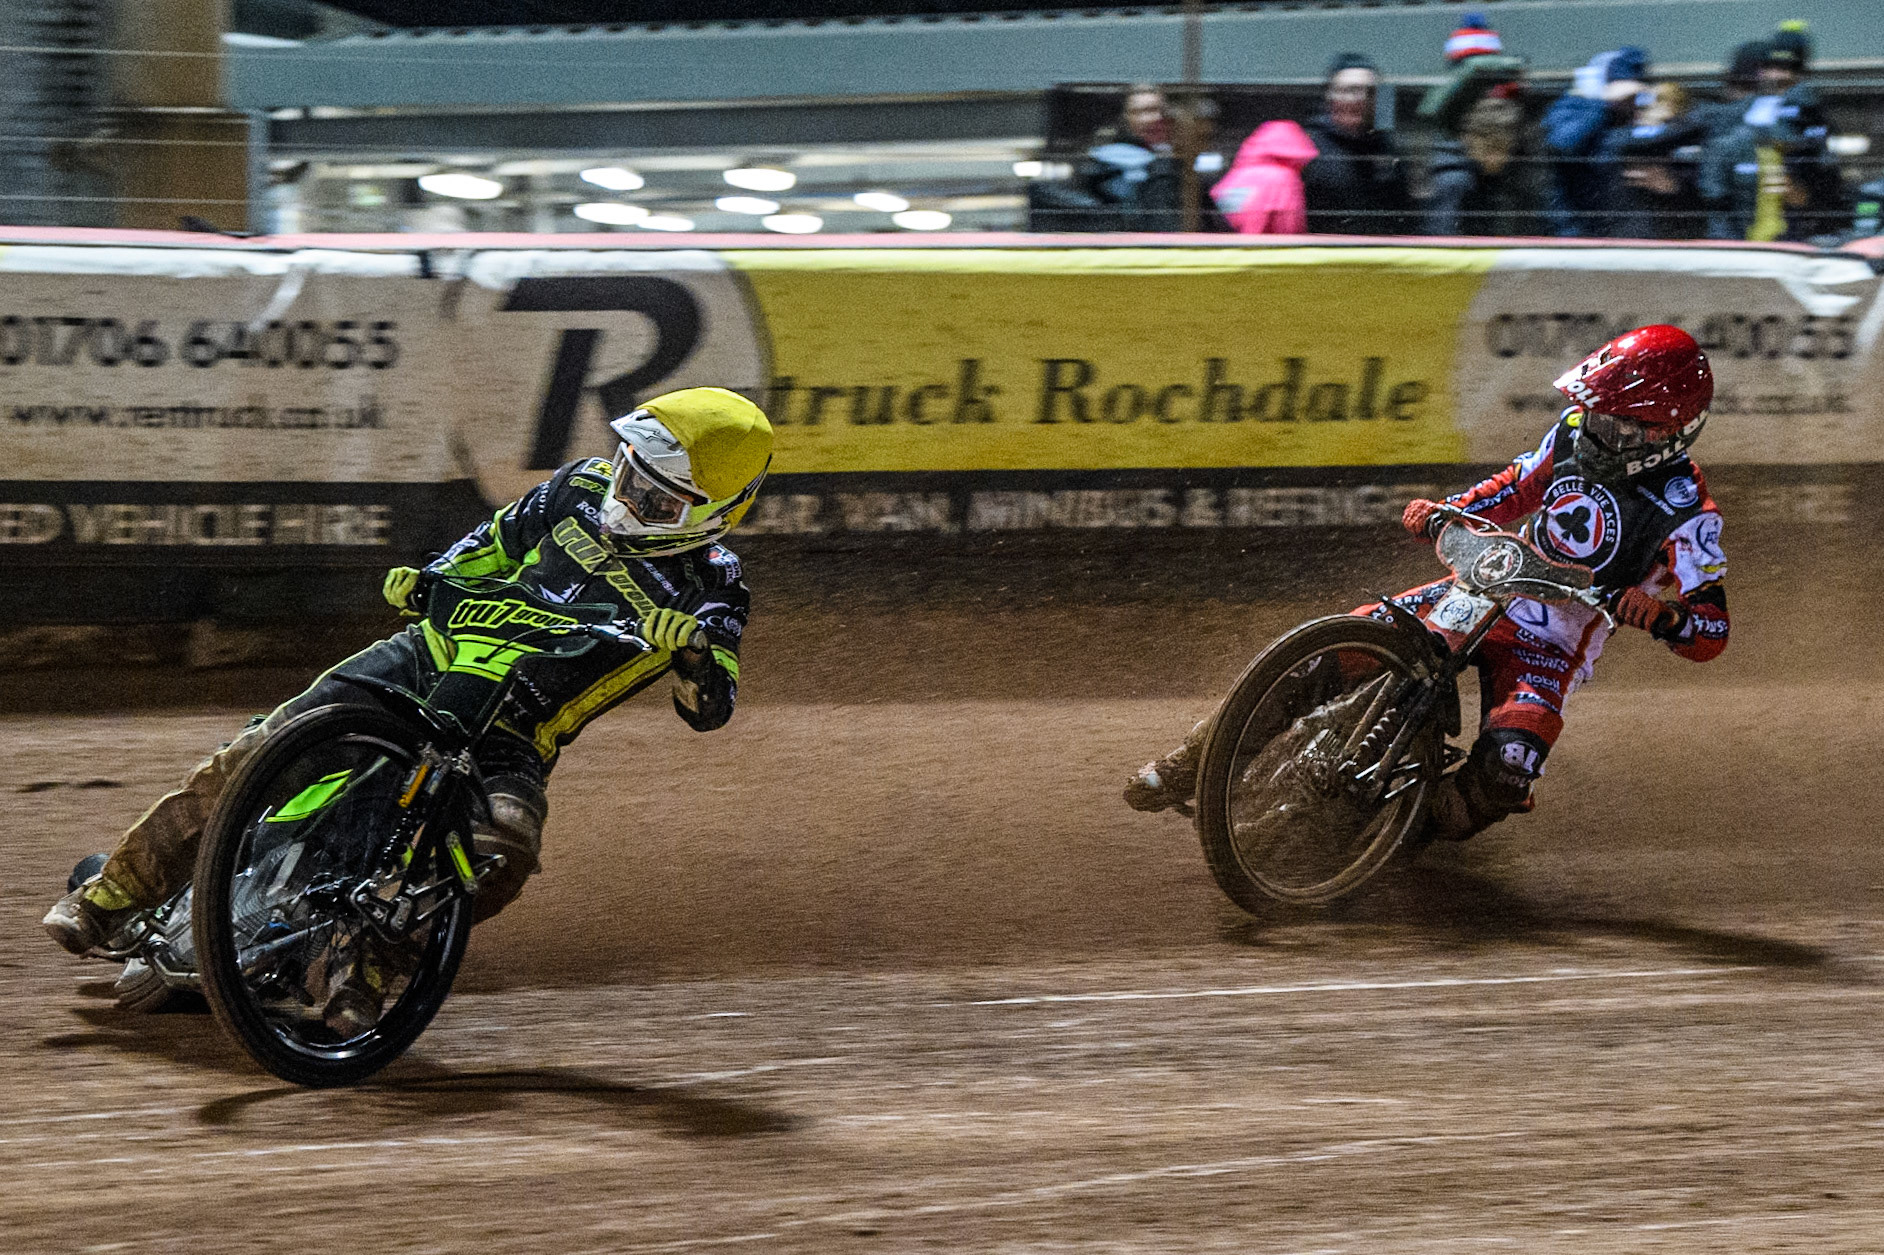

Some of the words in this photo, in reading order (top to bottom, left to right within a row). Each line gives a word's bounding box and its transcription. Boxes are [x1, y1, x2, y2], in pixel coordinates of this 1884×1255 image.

[0, 315, 169, 367] 01706
[765, 357, 1001, 426] truck
[1033, 356, 1430, 425] Rochdale
[1552, 481, 1585, 498] BELLE
[1590, 487, 1610, 509] VUE
[1604, 511, 1617, 543] ACES
